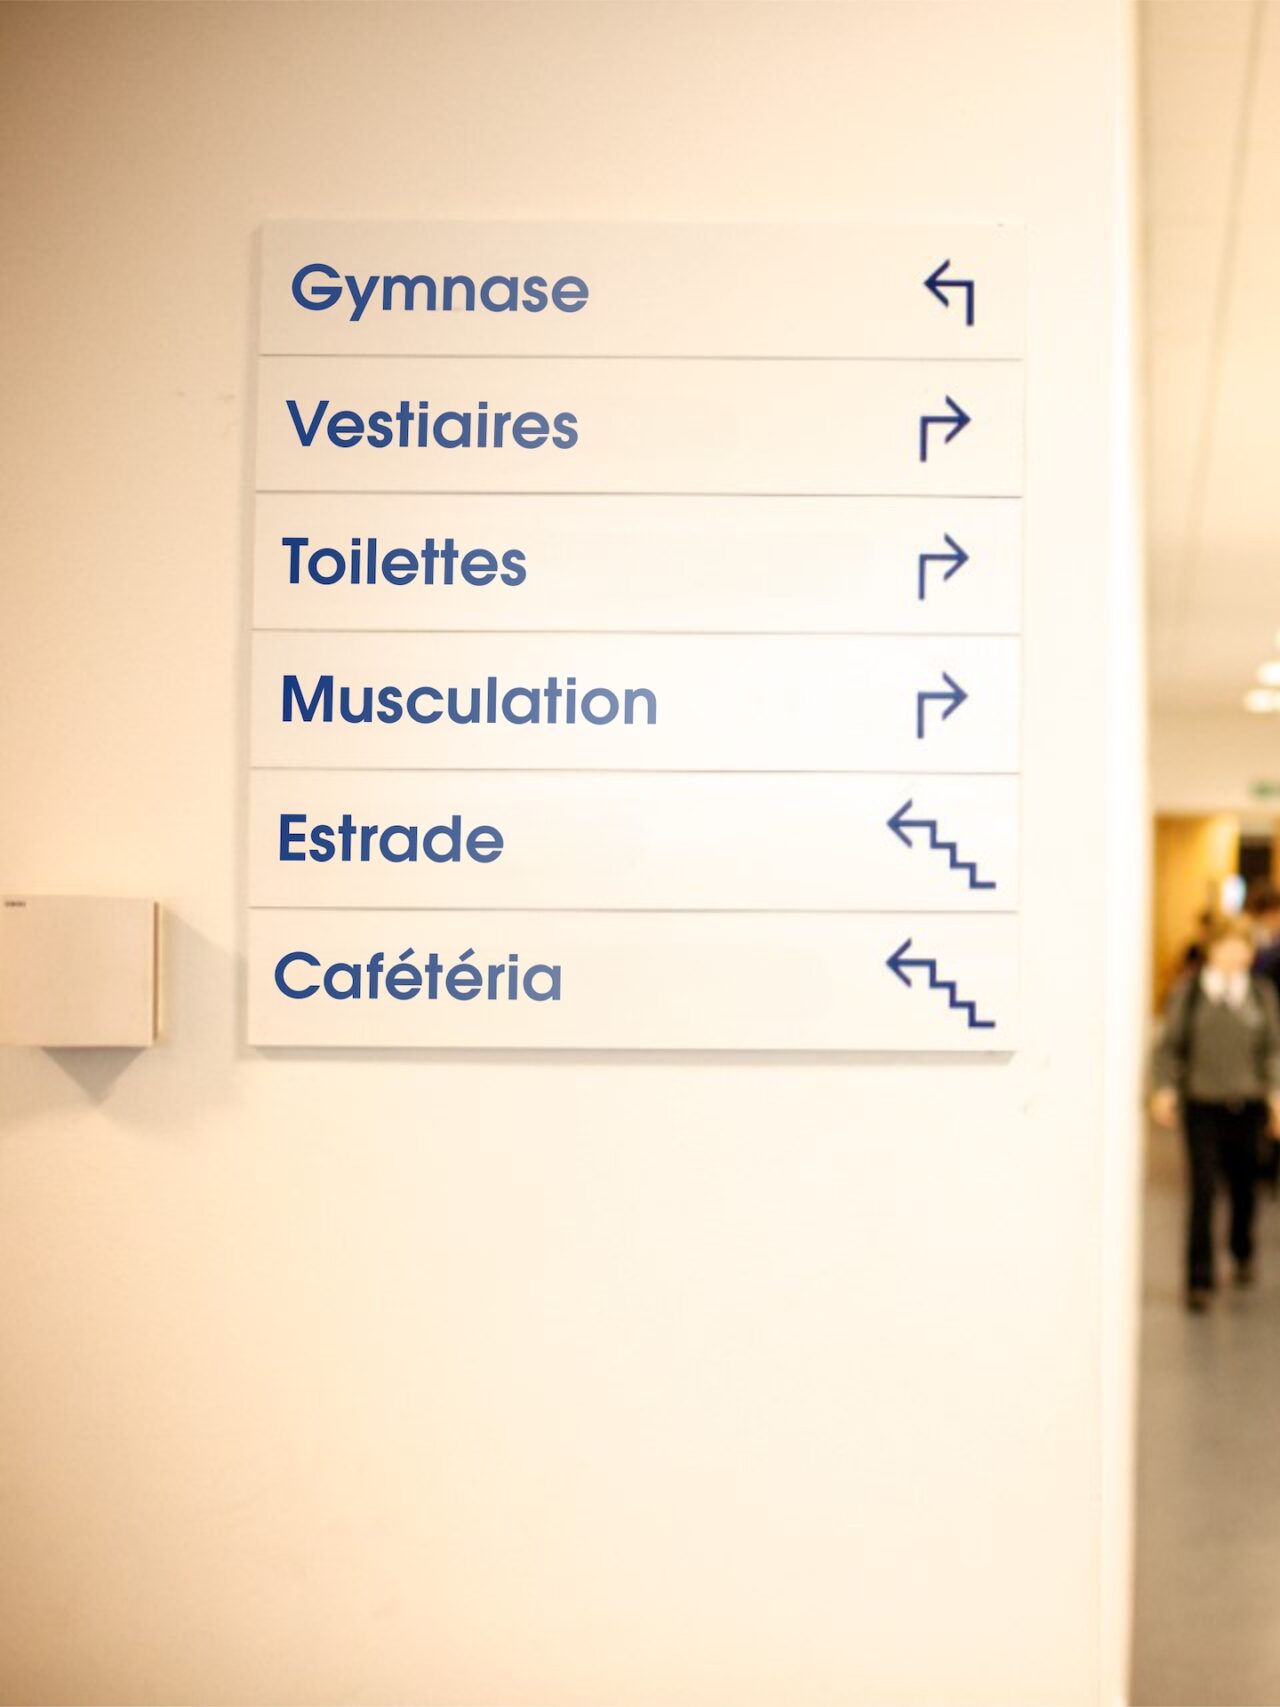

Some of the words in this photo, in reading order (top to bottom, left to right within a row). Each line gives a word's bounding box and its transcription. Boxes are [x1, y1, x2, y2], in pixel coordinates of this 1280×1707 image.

[291, 262, 588, 321] Gymnase
[286, 399, 578, 449] Vestiaires
[281, 536, 528, 587] Toilettes
[281, 674, 657, 726] Musculation
[279, 812, 505, 864] Estrade
[274, 947, 562, 1002] Cafétéria
